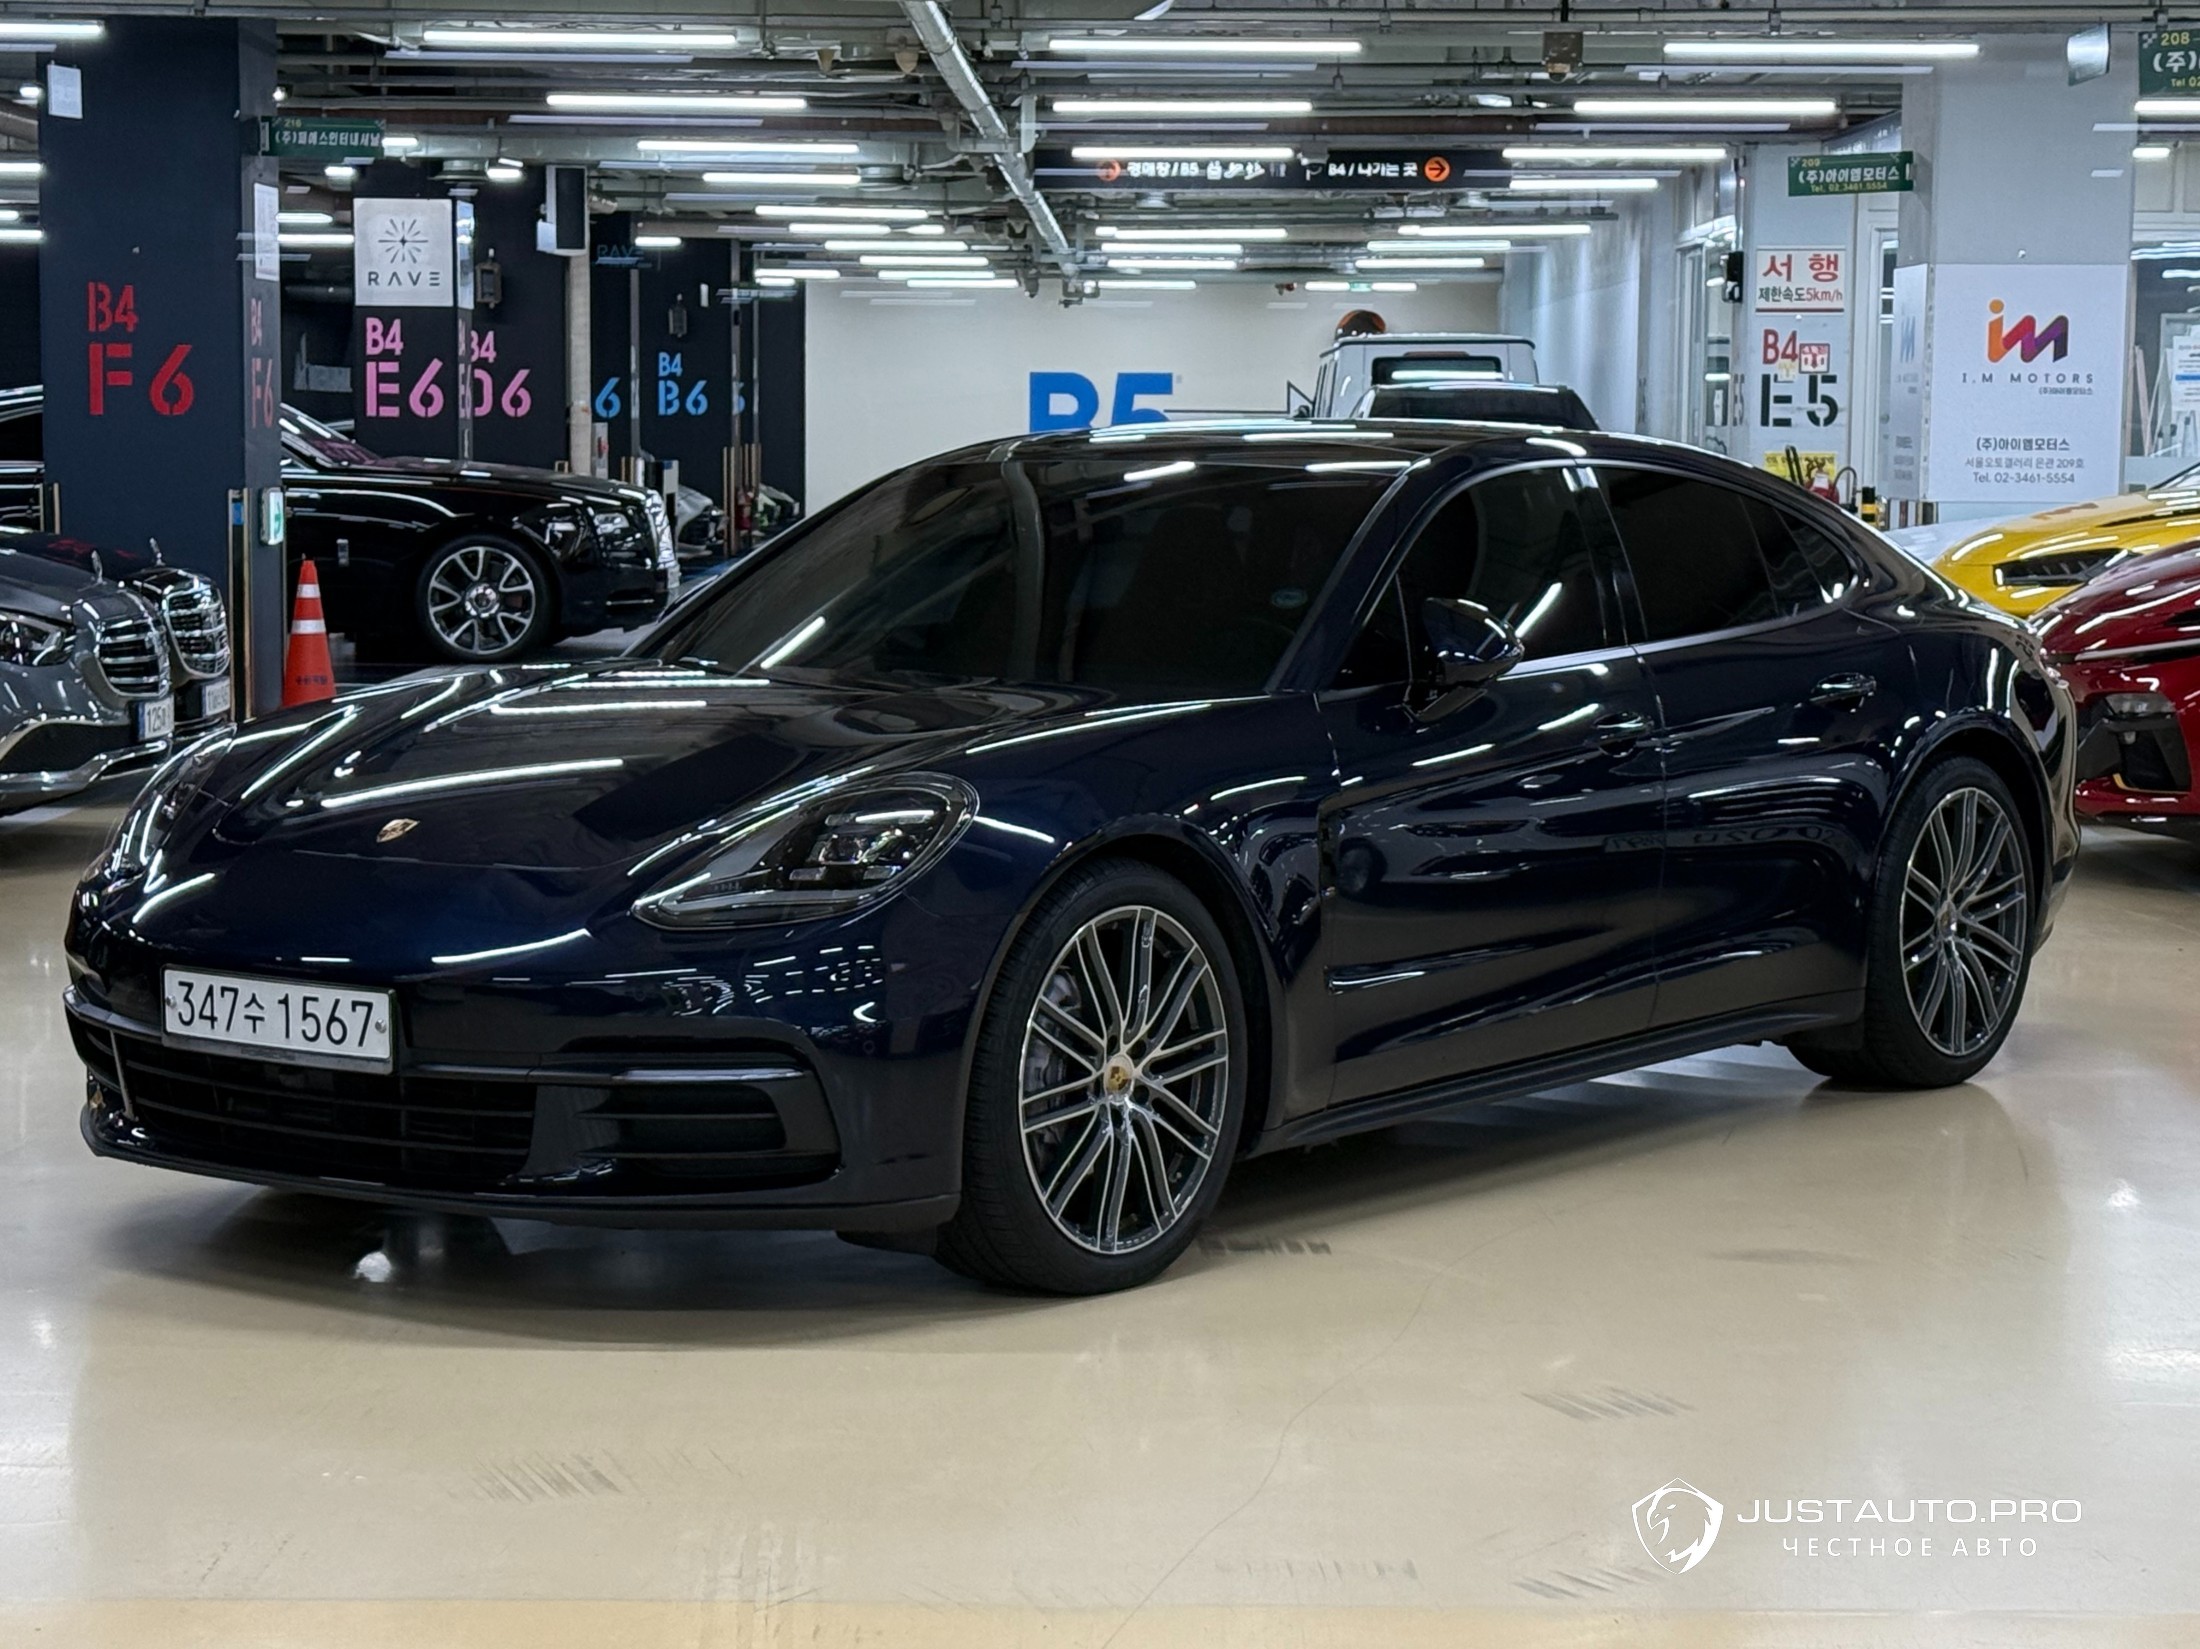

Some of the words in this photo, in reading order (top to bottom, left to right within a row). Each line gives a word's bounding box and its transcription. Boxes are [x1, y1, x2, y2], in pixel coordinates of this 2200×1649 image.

[2160, 32, 2190, 46] 208
[1357, 162, 1400, 178] 나가는
[1402, 162, 1418, 177] 곳
[367, 271, 440, 286] RAVE
[88, 281, 138, 333] B4
[365, 317, 404, 356] B4
[1763, 328, 1798, 365] B4
[658, 352, 682, 377] B4
[365, 358, 444, 418] E6
[2010, 373, 2093, 383] MOTORS
[658, 380, 708, 416] B6
[1976, 437, 2070, 451] (주)아이엠모터스
[1994, 472, 2075, 483] 02-3461-5554
